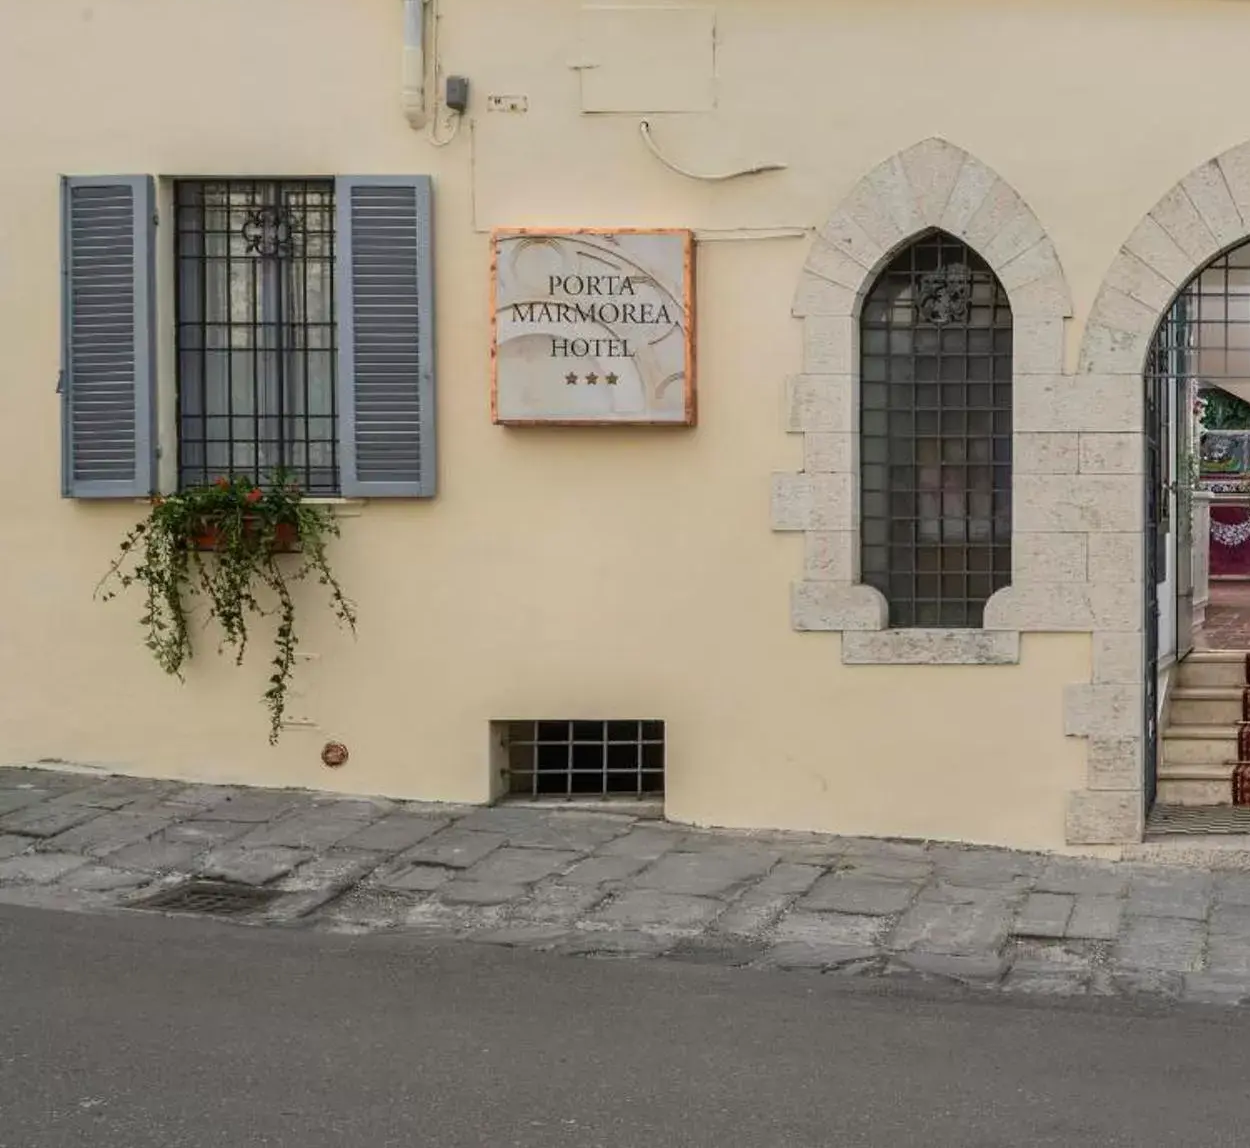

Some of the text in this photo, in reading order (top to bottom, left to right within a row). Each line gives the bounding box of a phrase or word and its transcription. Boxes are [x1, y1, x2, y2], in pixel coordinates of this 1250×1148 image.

[549, 275, 635, 295] PORTA
[512, 303, 671, 325] MARMOREA
[551, 339, 635, 357] HOTEL
